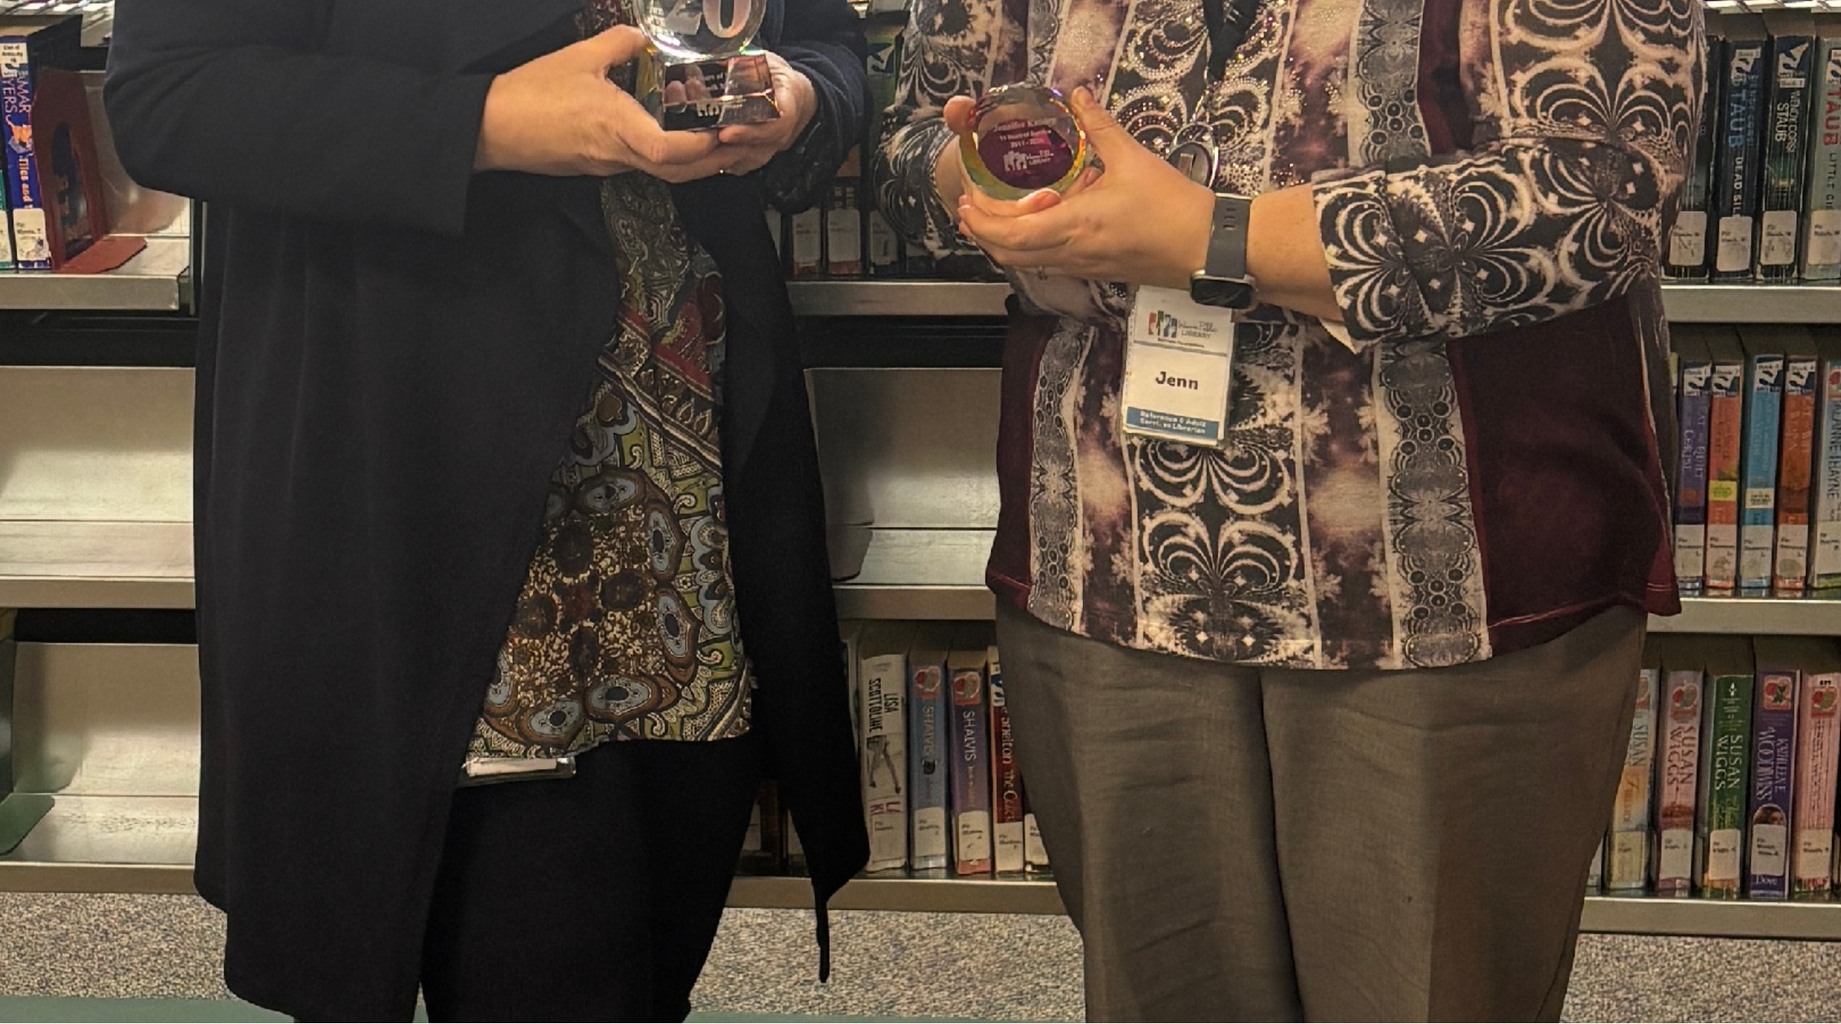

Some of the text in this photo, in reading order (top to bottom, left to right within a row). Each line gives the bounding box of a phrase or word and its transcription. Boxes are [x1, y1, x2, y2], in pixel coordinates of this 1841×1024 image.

[15, 73, 31, 114] AMAR
[1774, 102, 1791, 143] STAUB
[19, 158, 30, 202] Tiles and
[1732, 155, 1744, 190] DEAD
[1155, 370, 1199, 391] Jenn
[1140, 410, 1178, 423] Reference
[1185, 418, 1207, 428] Adult
[1140, 417, 1206, 435] Servies Librarian
[869, 677, 884, 733] SCOTTOLINE
[883, 692, 899, 713] LISA
[923, 706, 936, 757] SHALVIS
[962, 709, 978, 761] SHALVIS
[1632, 724, 1650, 767] SUSAN
[1666, 725, 1682, 786] WIGGS
[1680, 725, 1698, 785] SUSAN
[1714, 734, 1729, 791] WIGGS
[1727, 734, 1744, 790] SUSAN
